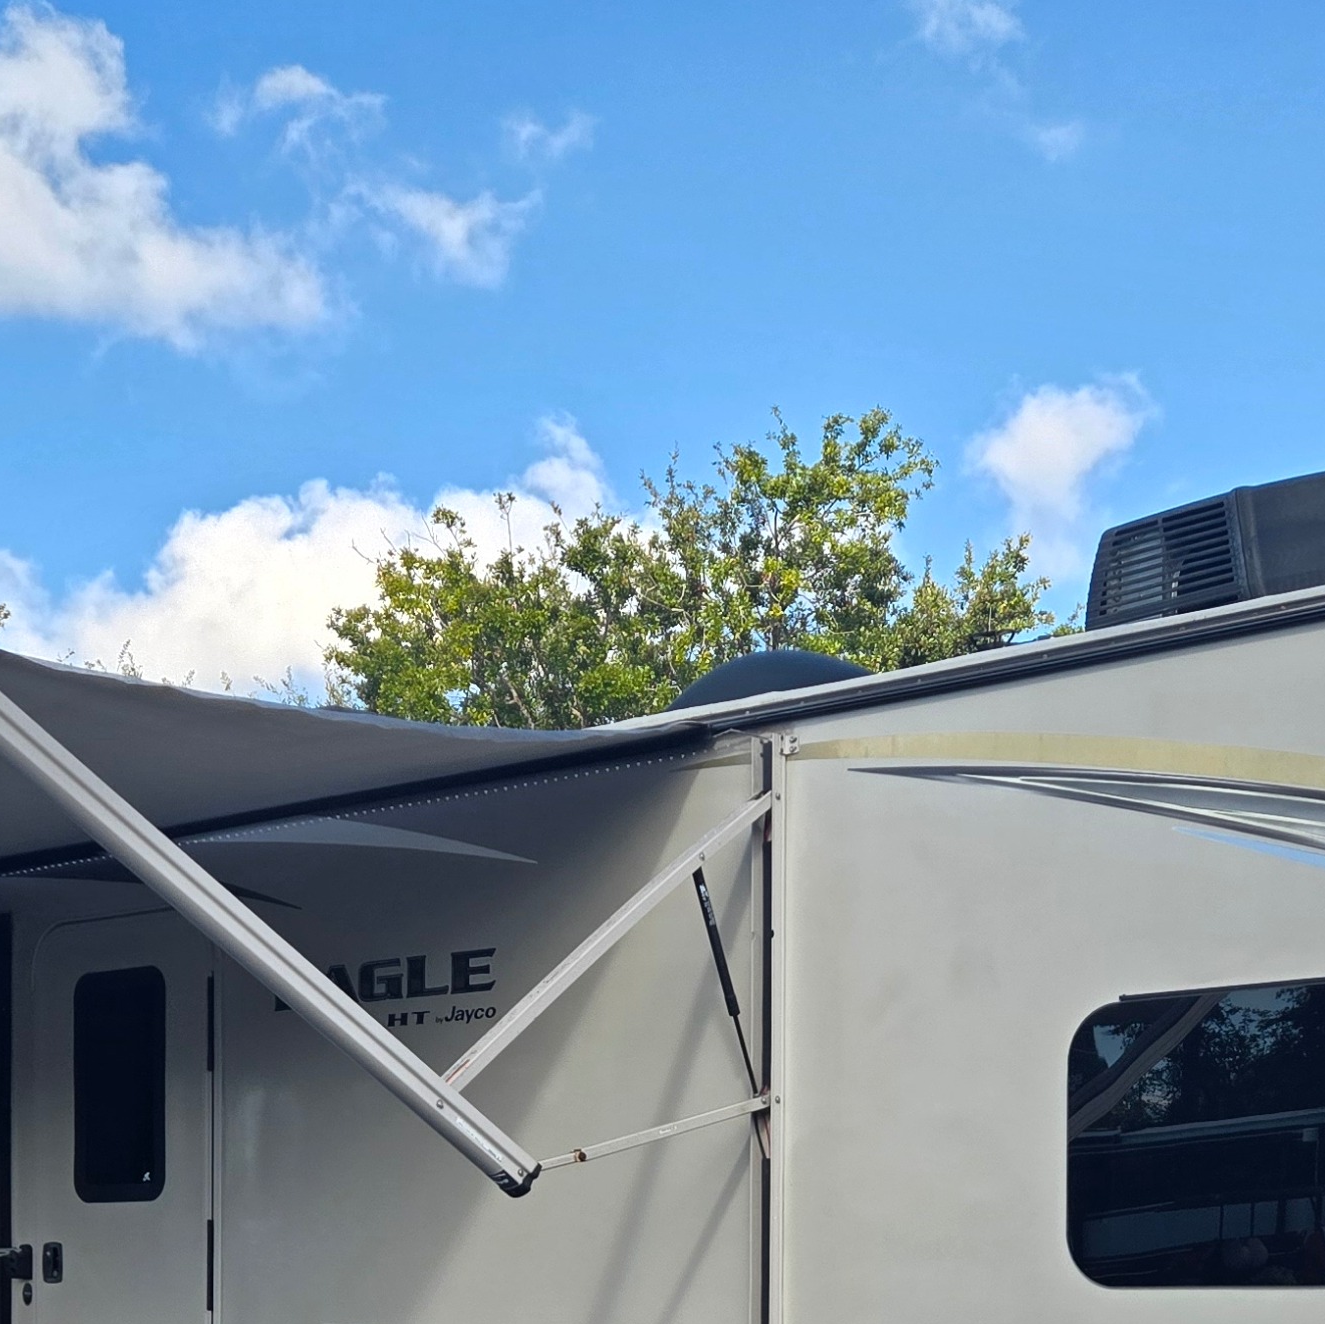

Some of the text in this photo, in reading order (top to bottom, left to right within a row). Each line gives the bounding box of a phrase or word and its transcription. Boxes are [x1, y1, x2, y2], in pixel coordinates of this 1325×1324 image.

[275, 948, 497, 1011] AGLE
[387, 1011, 430, 1027] HT
[445, 1006, 497, 1025] Jayco
